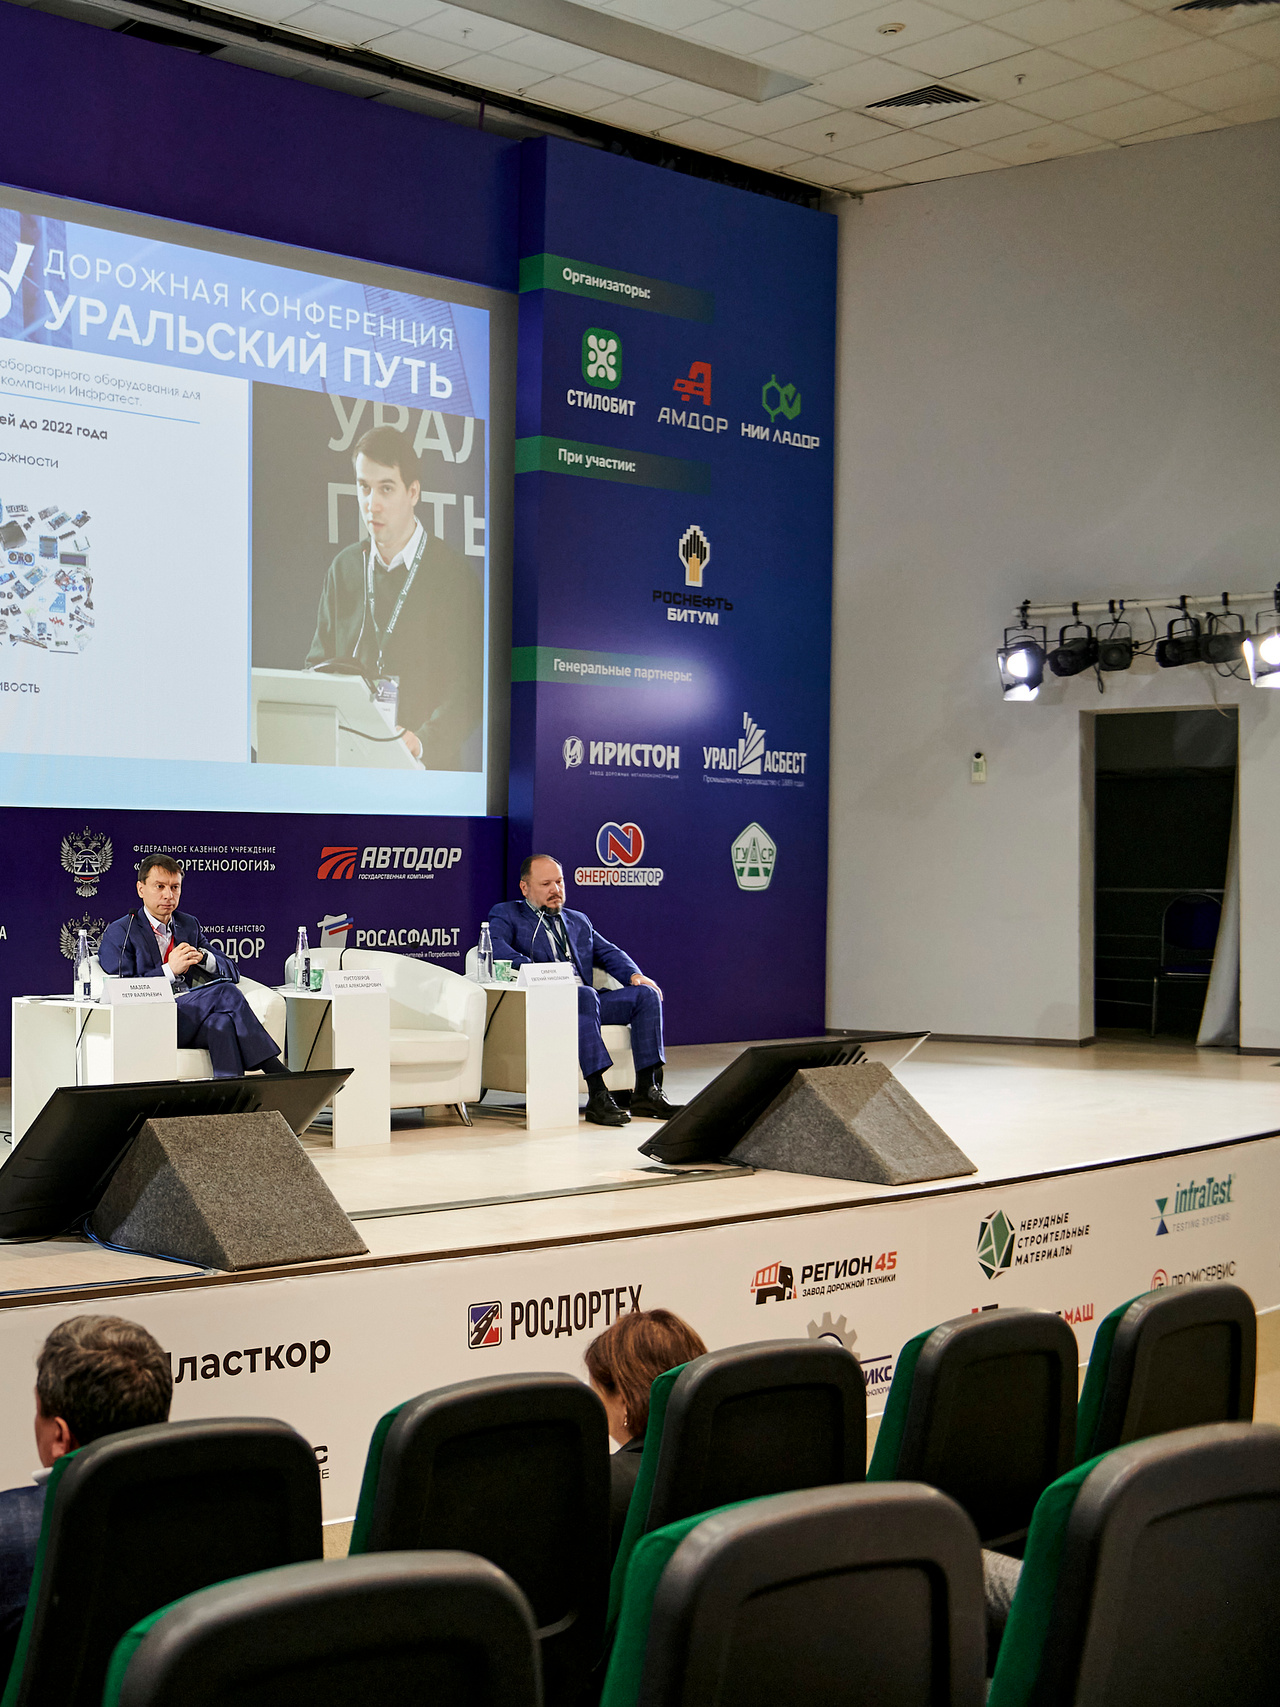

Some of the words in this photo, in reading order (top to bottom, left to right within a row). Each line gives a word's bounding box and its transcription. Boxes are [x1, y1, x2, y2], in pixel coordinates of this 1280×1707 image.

[562, 267, 650, 299] Организаторы:
[43, 249, 229, 307] ДОРОЖНАЯ
[241, 287, 453, 351] КОНФЕРЕНЦИЯ
[44, 291, 327, 378] УРАЛЬСКИЙ
[343, 347, 453, 399] ПУТЬ
[1, 375, 66, 394] компании
[69, 384, 142, 408] Инфратест.
[94, 373, 180, 397] оборудования
[183, 389, 201, 400] для
[567, 389, 636, 416] СТИЛОБИТ
[20, 417, 37, 431] до
[42, 419, 73, 435] 2022
[77, 425, 108, 440] года
[657, 407, 728, 434] АМДОР
[741, 422, 769, 441] НИИ
[773, 429, 820, 450] ЛАДОР
[558, 448, 582, 464] При
[585, 452, 636, 473] участии:
[652, 590, 733, 611] РОСНЕФТЬ
[667, 607, 719, 626] БИТУМ
[554, 658, 631, 677] Генеральные
[634, 667, 692, 683] партнеры:
[589, 741, 680, 771] ИРИСТОН
[703, 746, 736, 770] УРАЛ
[763, 751, 807, 774] АСБЕСТ
[133, 845, 187, 853] ФЕДЕРАЛЬНОЕ
[190, 845, 228, 854] КАЗЕННОЕ
[230, 846, 276, 854] УЧРЕЖДЕНИЕ
[360, 847, 462, 871] АВТОДОР
[576, 868, 663, 885] ЭНЕРГОВЕКТОР
[356, 928, 460, 947] РОСАСФАЛЬТ
[1174, 1174, 1232, 1214] infraTest
[1020, 1212, 1069, 1232] НЕРУДНЫЕ
[1173, 1219, 1200, 1232] TESTING
[1017, 1224, 1090, 1248] СТРОИТЕЛЬНЫЕ
[801, 1255, 873, 1284] РЕГИОН
[875, 1251, 897, 1271] 45
[1015, 1244, 1072, 1266] МАТЕРИАЛЫ
[802, 1286, 825, 1297] ЗАВОД
[826, 1278, 865, 1294] ДОРОЖНОЙ
[867, 1274, 896, 1285] ТЕХНИКИ
[164, 1339, 331, 1384] ласткор
